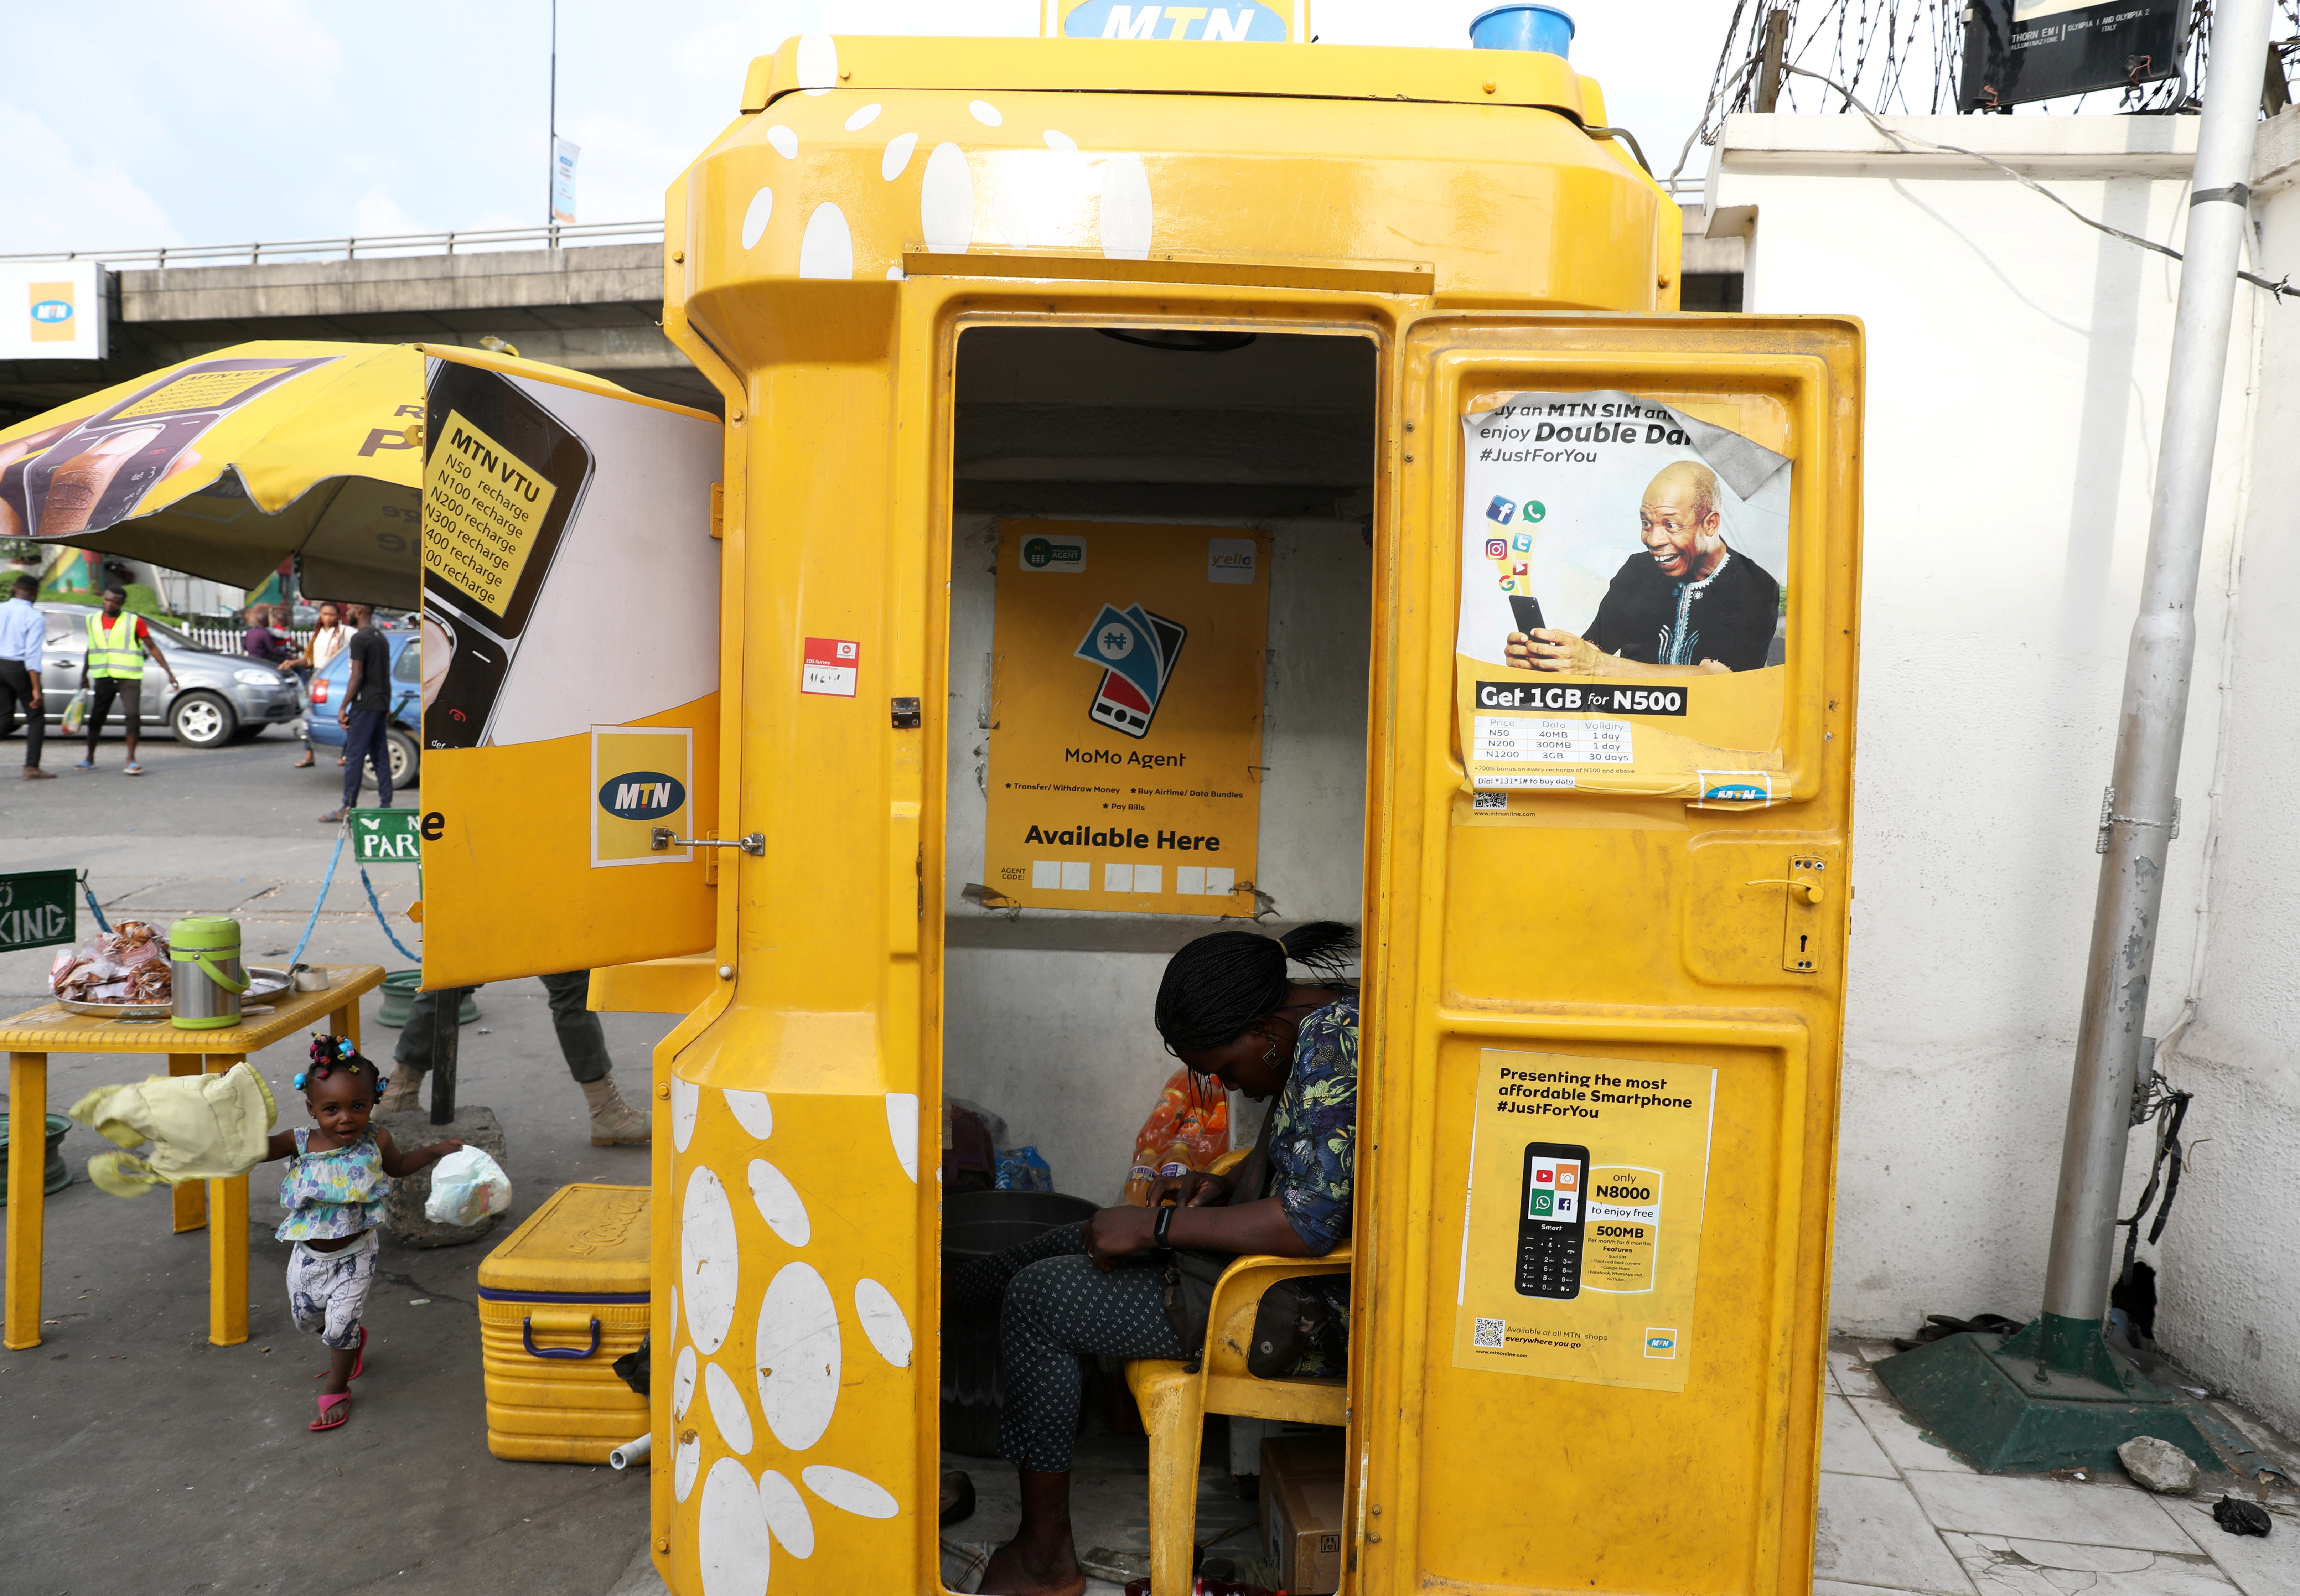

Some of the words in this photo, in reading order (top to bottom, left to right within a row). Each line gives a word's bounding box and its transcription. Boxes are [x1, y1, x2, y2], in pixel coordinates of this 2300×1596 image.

[1101, 5, 1255, 41] MTN
[2068, 20, 2093, 31] OLYMPIA
[2102, 16, 2115, 25] AND
[2116, 10, 2142, 21] OLYMPIA
[2102, 24, 2117, 32] ITALY
[2012, 30, 2038, 43] THORN
[2042, 26, 2059, 37] EMI
[2011, 36, 2058, 50] ILLUMINAZIONE
[37, 304, 67, 319] MTN
[185, 373, 231, 382] MTN
[178, 391, 232, 399] recharge
[189, 385, 242, 393] recharge
[134, 402, 170, 410] N400
[171, 396, 222, 404] recharge
[160, 402, 212, 411] recharge
[1520, 406, 1542, 416] an
[1547, 403, 1597, 417] MTN
[1600, 404, 1641, 418] SIM
[1480, 425, 1531, 442] enjoy
[1535, 422, 1637, 444] Double
[1480, 448, 1597, 462] #JustForYou
[450, 427, 499, 473] MTN
[501, 462, 540, 502] VTU
[131, 472, 144, 481] def
[148, 466, 156, 478] 3
[445, 454, 471, 479] N50
[478, 480, 529, 522] recharge
[438, 470, 470, 500] N100
[472, 497, 523, 539] recharge
[430, 486, 463, 517] N200
[465, 513, 516, 555] recharge
[425, 503, 456, 533] N300
[457, 530, 509, 571] recharge
[450, 546, 502, 587] recharge
[442, 563, 495, 604] recharge
[1481, 686, 1524, 706] Get
[1531, 688, 1582, 709] 1GB
[1587, 693, 1609, 705] for
[1613, 690, 1681, 711] N500
[1490, 719, 1515, 727] Price
[1585, 722, 1624, 732] Validity
[431, 739, 446, 749] def
[1602, 732, 1620, 741] day
[1602, 743, 1621, 751] day
[1065, 748, 1122, 764] MoMo
[1127, 751, 1186, 769] Agent
[1605, 753, 1629, 762] days
[615, 783, 671, 809] MTN
[1094, 786, 1120, 794] Money
[1716, 789, 1756, 800] MTN
[421, 812, 445, 841] e
[1024, 825, 1149, 848] Available
[1157, 830, 1220, 851] Here
[1501, 1068, 1591, 1088] Presenting
[1595, 1074, 1621, 1087] the
[1626, 1078, 1667, 1090] most
[1499, 1084, 1586, 1101] affordable
[1590, 1090, 1692, 1108] Smartphone
[1497, 1100, 1599, 1119] #JustForYou
[1613, 1173, 1637, 1185] only
[1596, 1185, 1650, 1200] N8000
[1604, 1207, 1631, 1218] enjoy
[1633, 1208, 1653, 1217] free
[1596, 1226, 1644, 1238] 500MB
[1506, 1326, 1541, 1335] Available
[1505, 1335, 1553, 1346] everywhere
[1476, 1349, 1528, 1358] www.mtnonline.com
